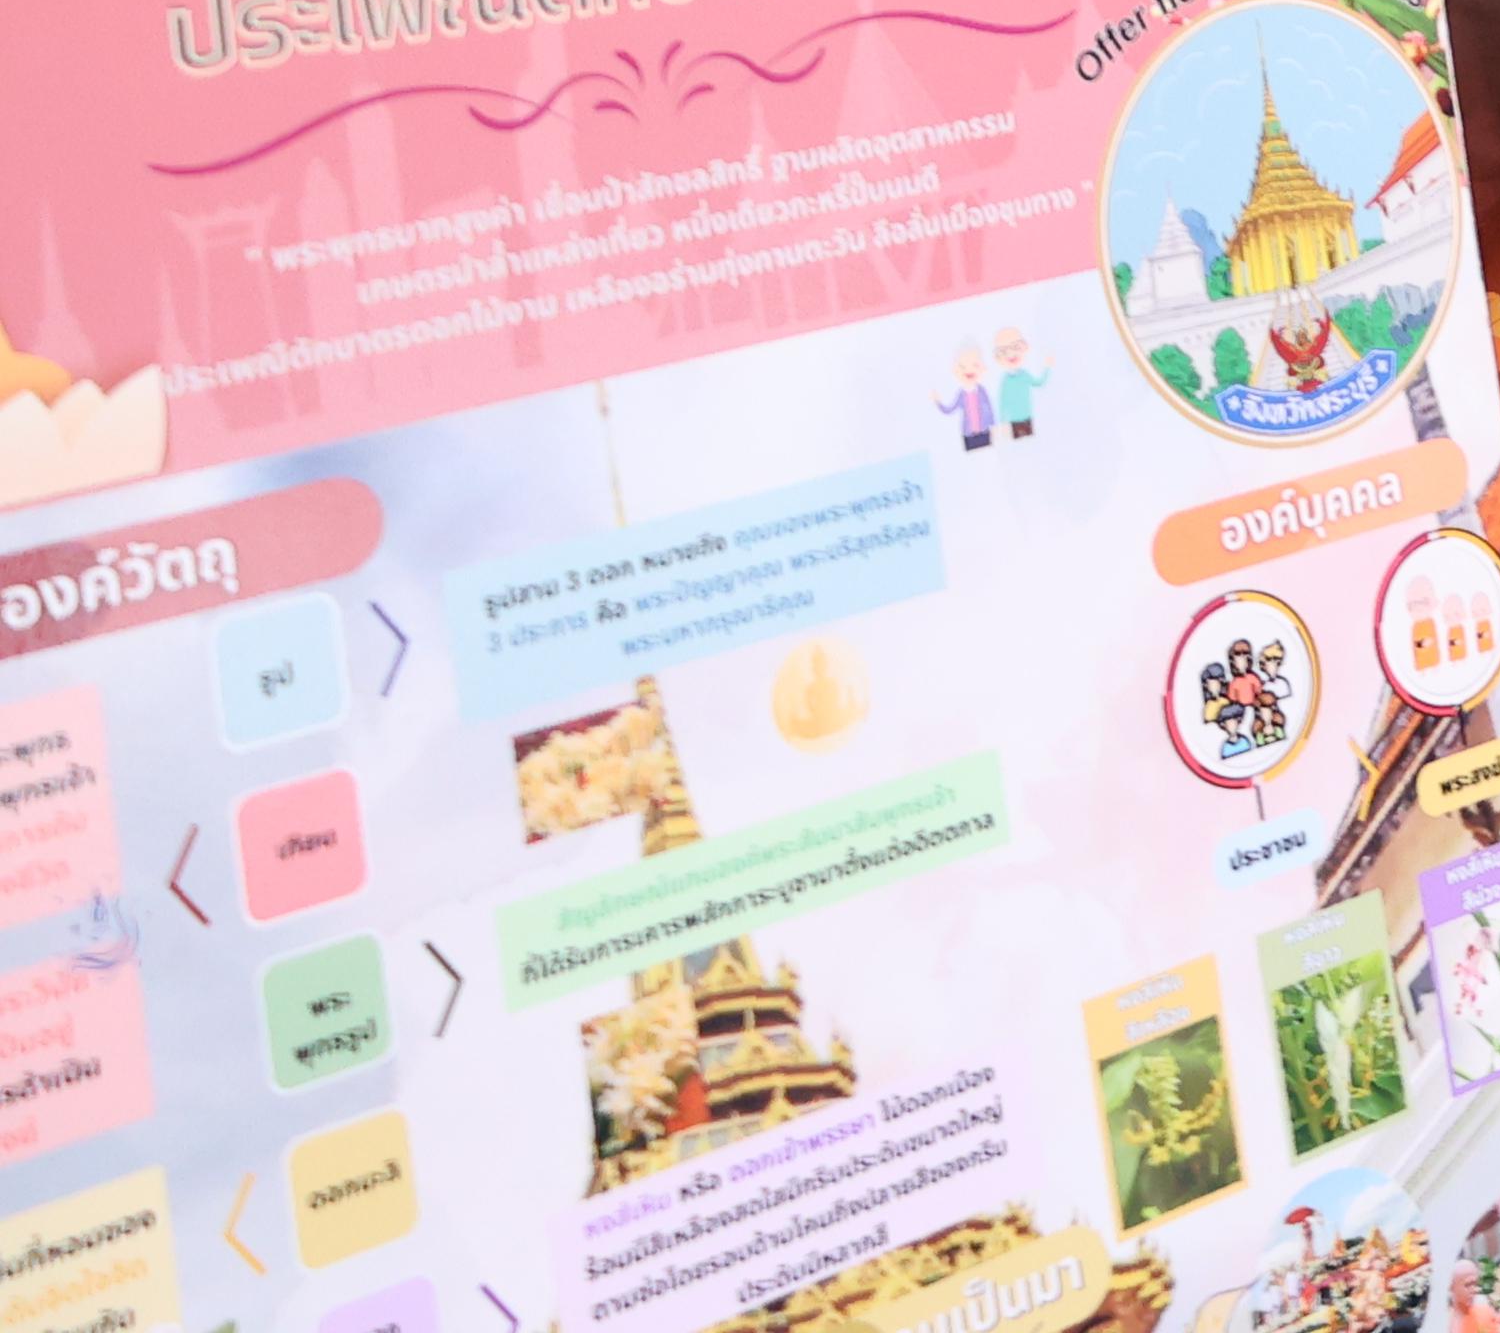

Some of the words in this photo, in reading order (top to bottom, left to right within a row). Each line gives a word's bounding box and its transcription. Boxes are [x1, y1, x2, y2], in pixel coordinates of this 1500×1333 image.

[1074, 5, 1149, 83] Offer
[1218, 467, 1405, 554] องค์บุคคล
[0, 537, 241, 630] องค์วัตถุ
[565, 570, 580, 592] 3
[1228, 830, 1308, 872] ประชาชน
